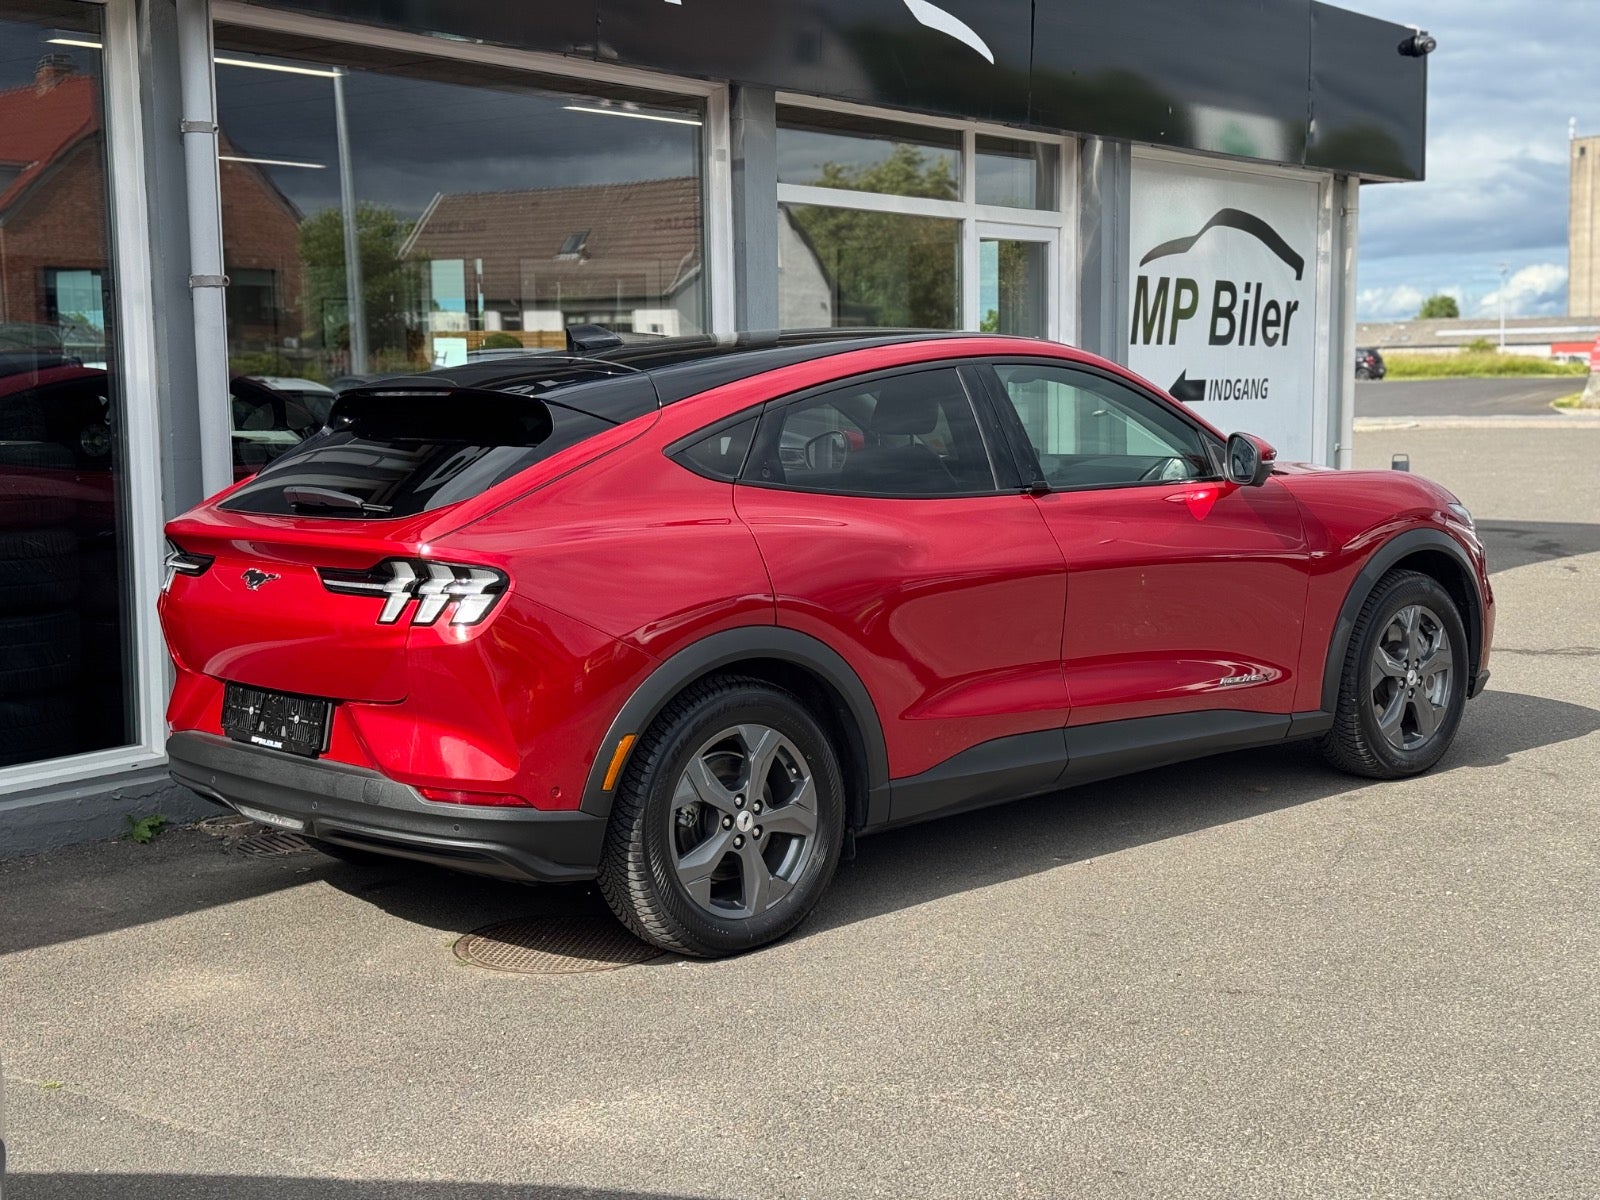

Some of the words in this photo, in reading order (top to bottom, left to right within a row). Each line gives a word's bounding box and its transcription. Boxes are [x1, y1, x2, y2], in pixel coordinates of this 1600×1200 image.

[1130, 275, 1199, 345] MP
[1208, 280, 1299, 347] Biler
[1208, 378, 1269, 401] INDGANG
